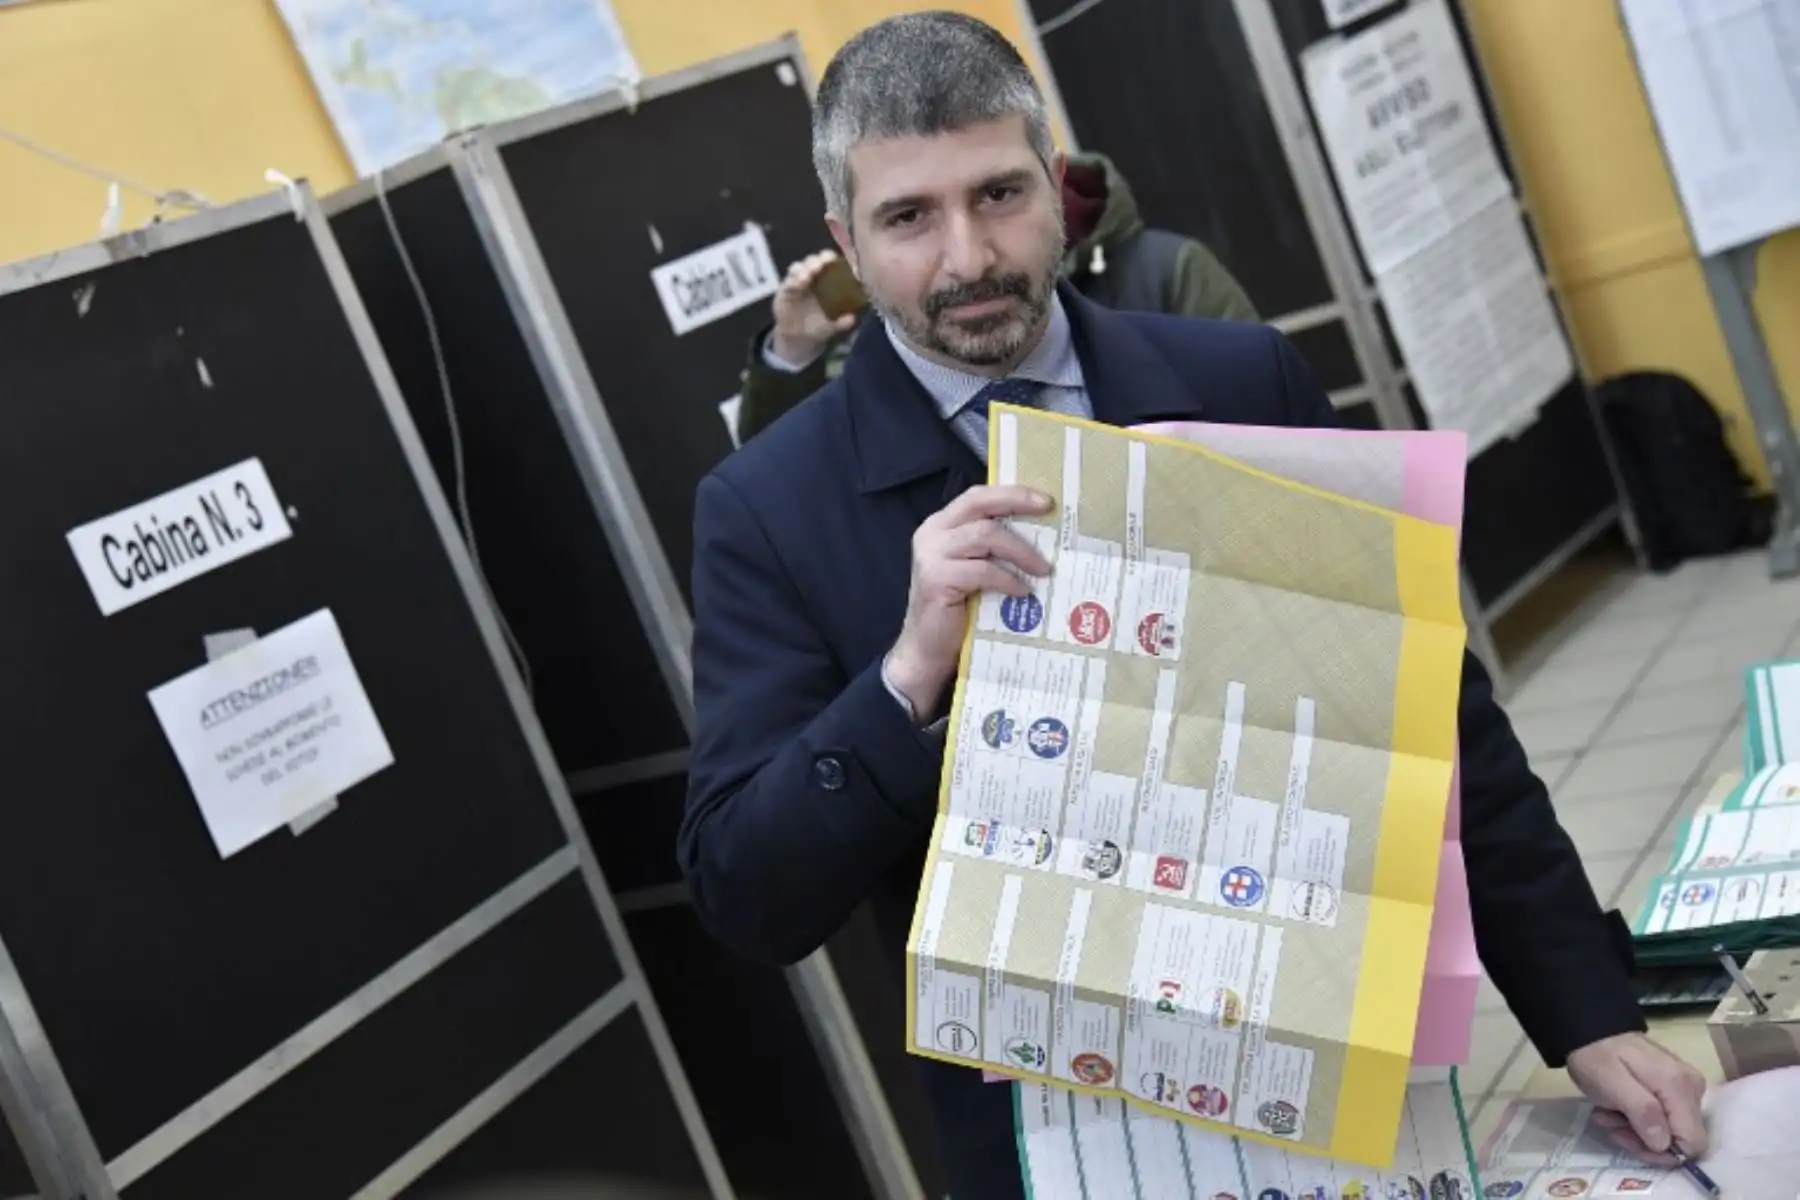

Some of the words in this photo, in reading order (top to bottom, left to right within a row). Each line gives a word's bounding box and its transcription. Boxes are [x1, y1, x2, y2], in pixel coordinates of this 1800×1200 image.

[671, 264, 733, 317] Cabina
[101, 514, 210, 589] Cabina
[198, 490, 244, 547] N.
[233, 480, 264, 532] 3
